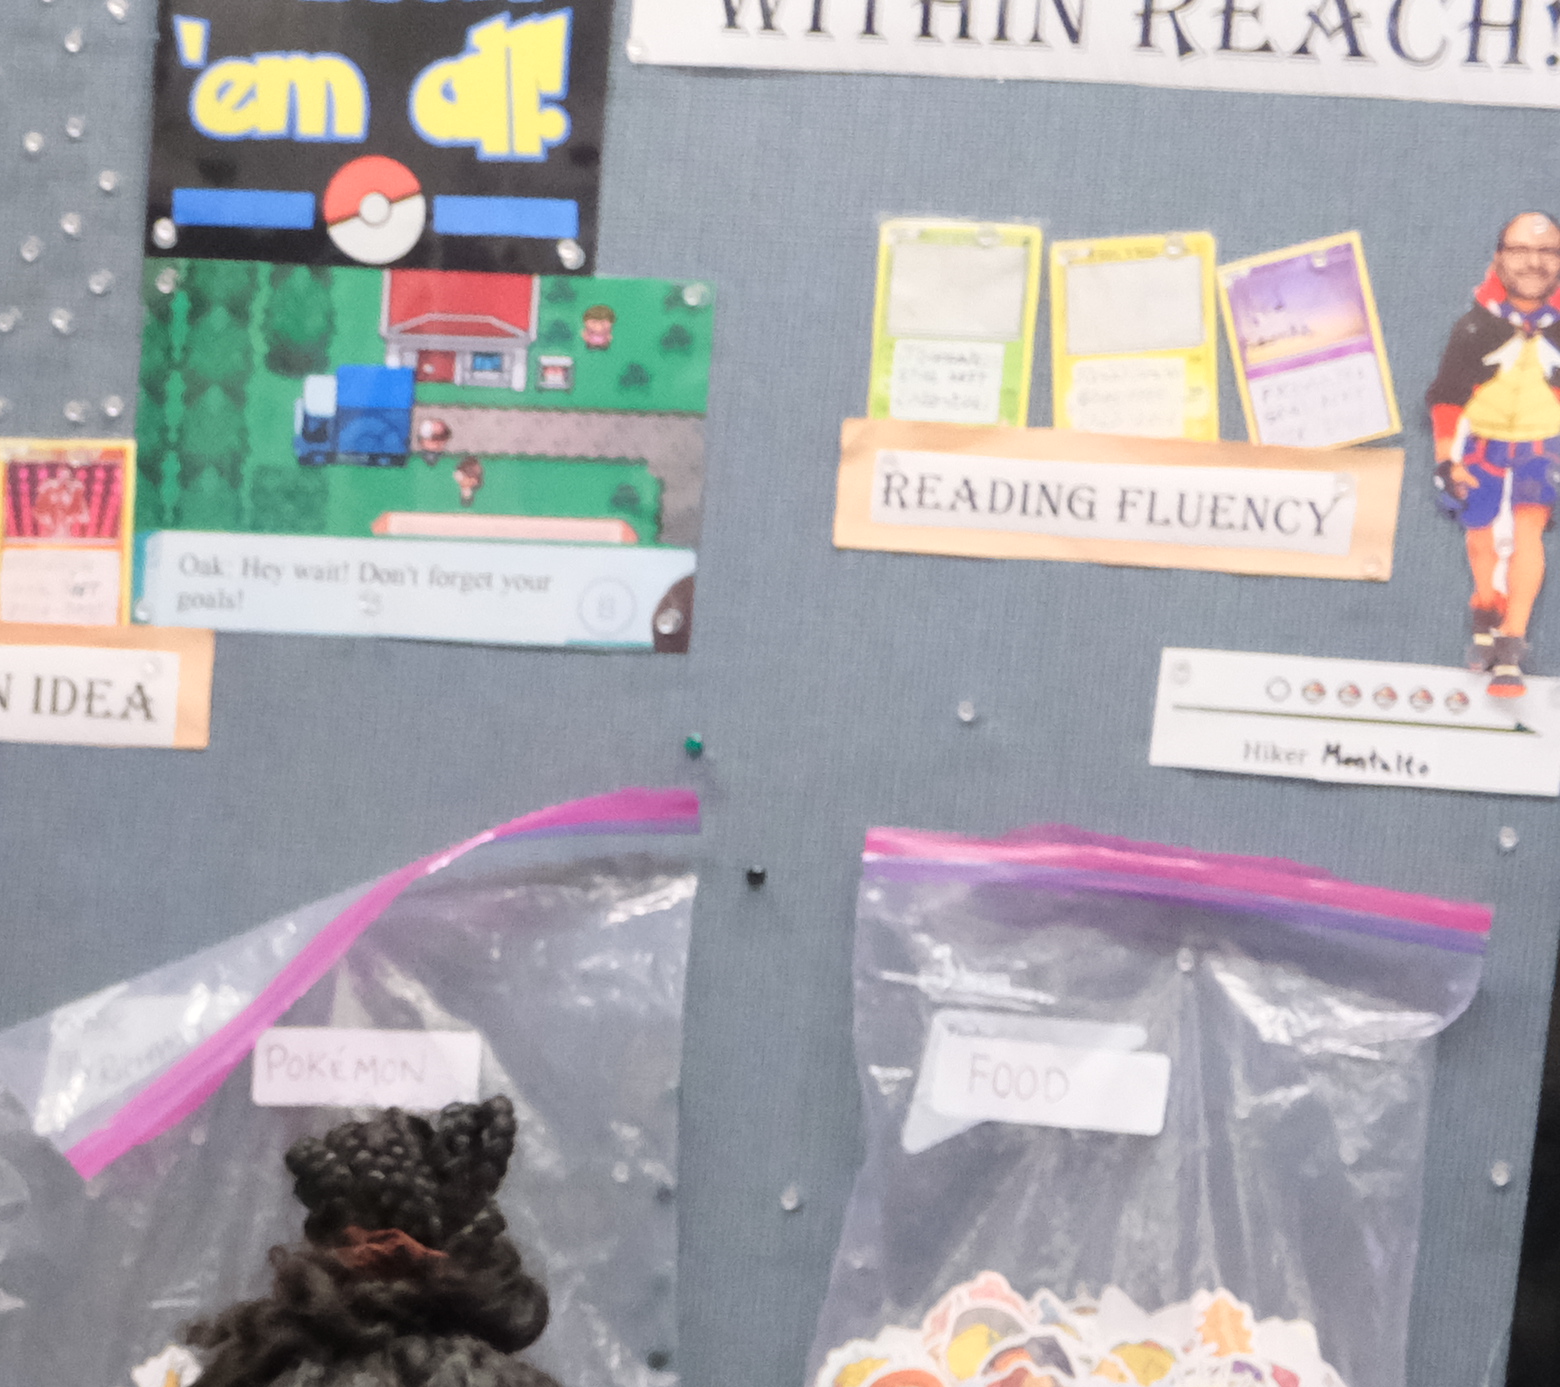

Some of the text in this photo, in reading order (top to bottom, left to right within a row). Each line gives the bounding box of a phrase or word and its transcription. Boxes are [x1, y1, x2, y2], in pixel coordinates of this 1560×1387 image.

[882, 470, 1348, 537] READING FLUENCY
[176, 551, 552, 597] Oak: Hey wait! Don't forget your
[175, 588, 245, 615] goals!
[31, 675, 158, 722] IDEA
[969, 1052, 1071, 1104] FOOD
